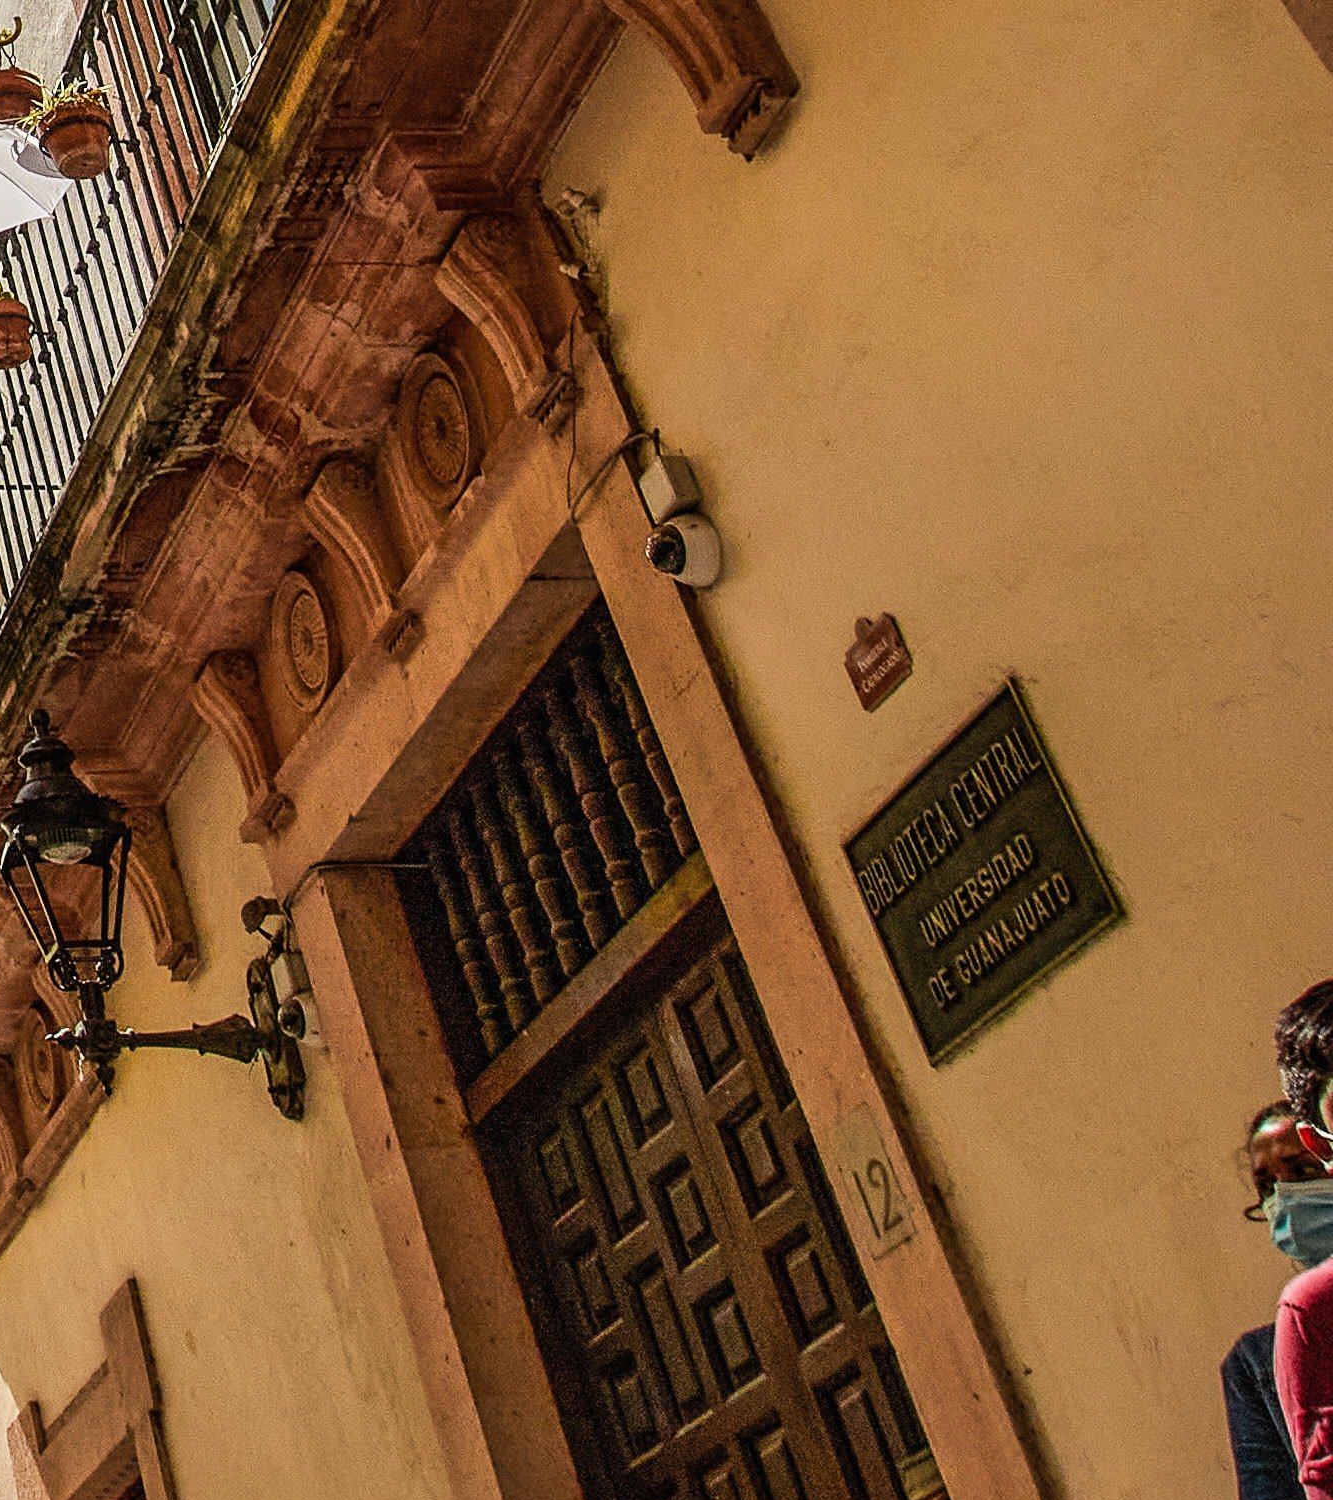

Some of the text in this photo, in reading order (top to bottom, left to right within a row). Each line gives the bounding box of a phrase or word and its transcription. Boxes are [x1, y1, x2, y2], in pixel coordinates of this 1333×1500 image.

[858, 727, 1042, 918] BIBLIOTECA CENTRAL
[919, 833, 1034, 948] UNIVERSIDAD
[927, 871, 1072, 1009] DE GUANAJUATO
[852, 1158, 904, 1240] 12
